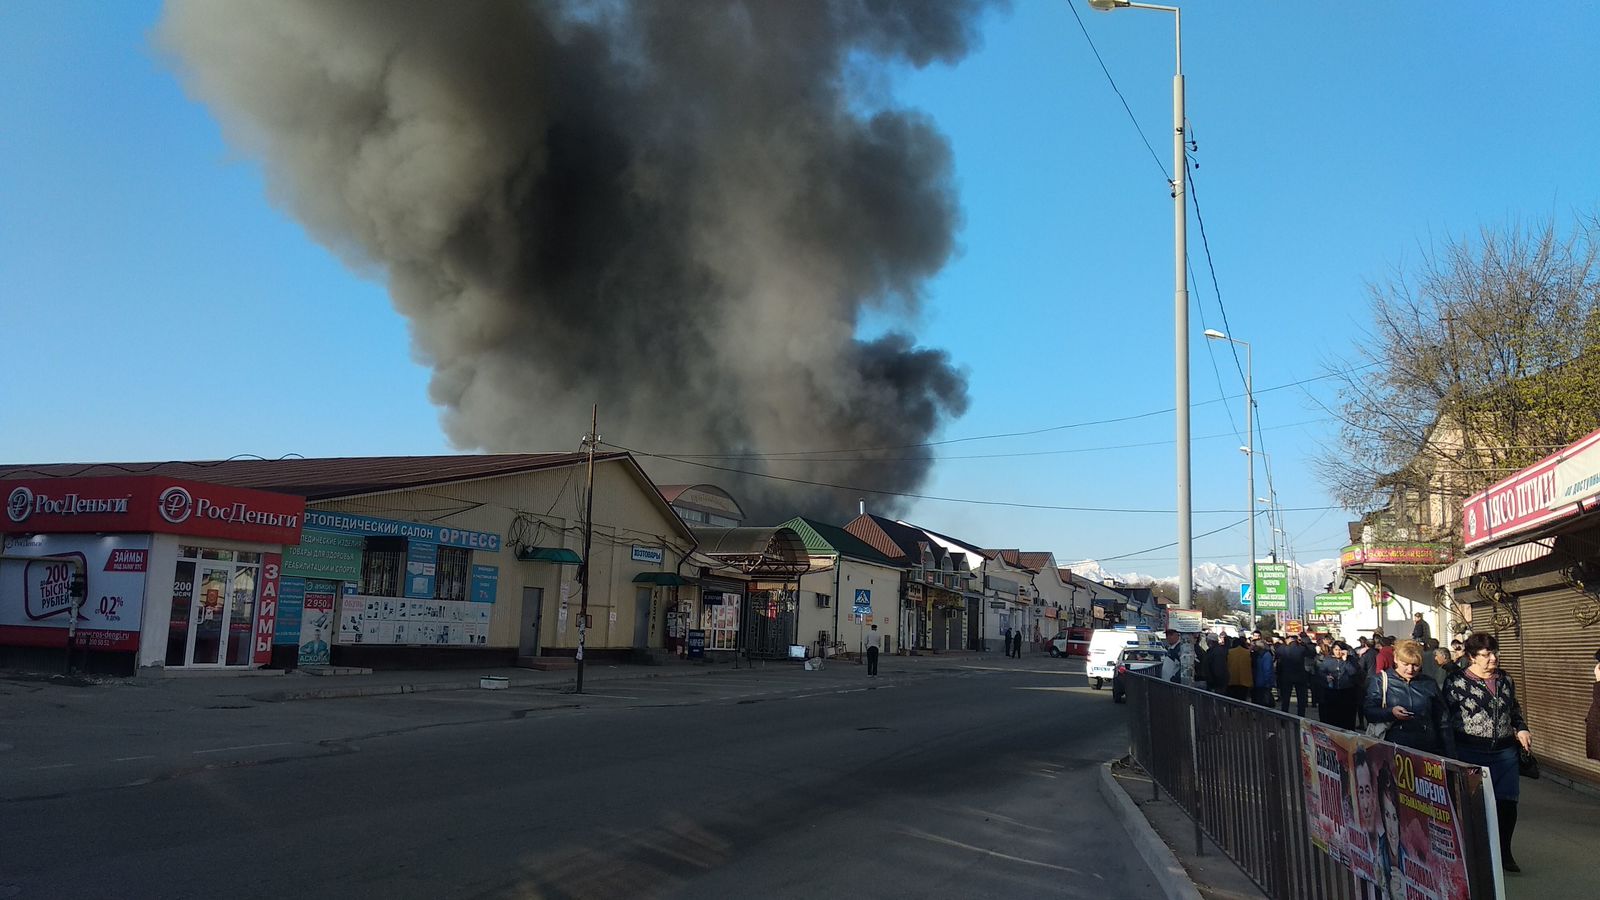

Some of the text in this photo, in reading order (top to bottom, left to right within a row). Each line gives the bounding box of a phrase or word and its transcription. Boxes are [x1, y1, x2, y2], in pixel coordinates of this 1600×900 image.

[34, 494, 129, 515] РосДеньги
[1481, 469, 1557, 531] МЯСО ПТИЦ
[196, 498, 298, 529] РосДеньги
[304, 512, 398, 535] РТОПЕДИЧЕСКИЙ
[401, 525, 433, 539] САЛОН
[114, 550, 144, 562] ЗАЙМЫ
[45, 564, 69, 585] 200
[40, 580, 71, 598] ТЫСЯЧ
[173, 581, 192, 591] 200
[42, 592, 70, 609] РУБЛЕЙ
[100, 596, 124, 617] 0,2%
[256, 564, 279, 652] ЗАЙМЫ
[1395, 753, 1443, 793] 20 19:00
[1415, 776, 1447, 805] АПРЕЛЯ
